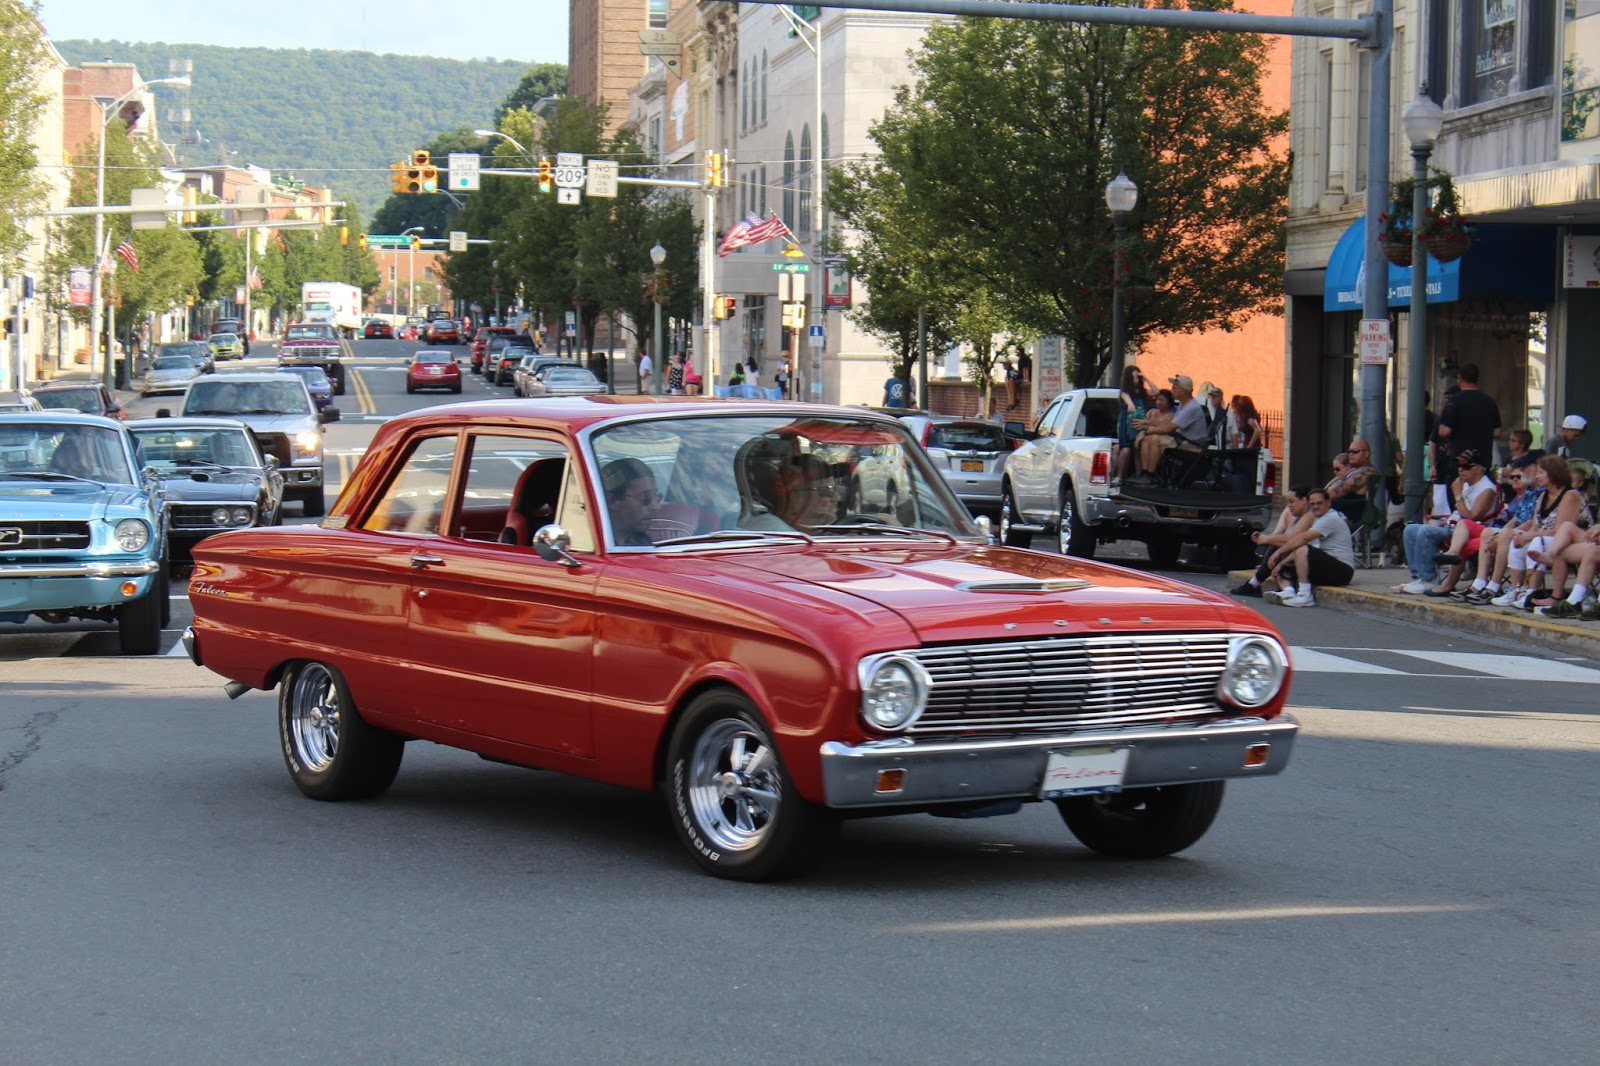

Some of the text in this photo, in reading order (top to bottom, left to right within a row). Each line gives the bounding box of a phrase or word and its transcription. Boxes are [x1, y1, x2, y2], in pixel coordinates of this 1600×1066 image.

[595, 164, 610, 172] NO
[556, 169, 582, 183] 209
[1369, 323, 1380, 331] NO
[1361, 333, 1388, 341] PARKING
[195, 582, 229, 596] Falcon
